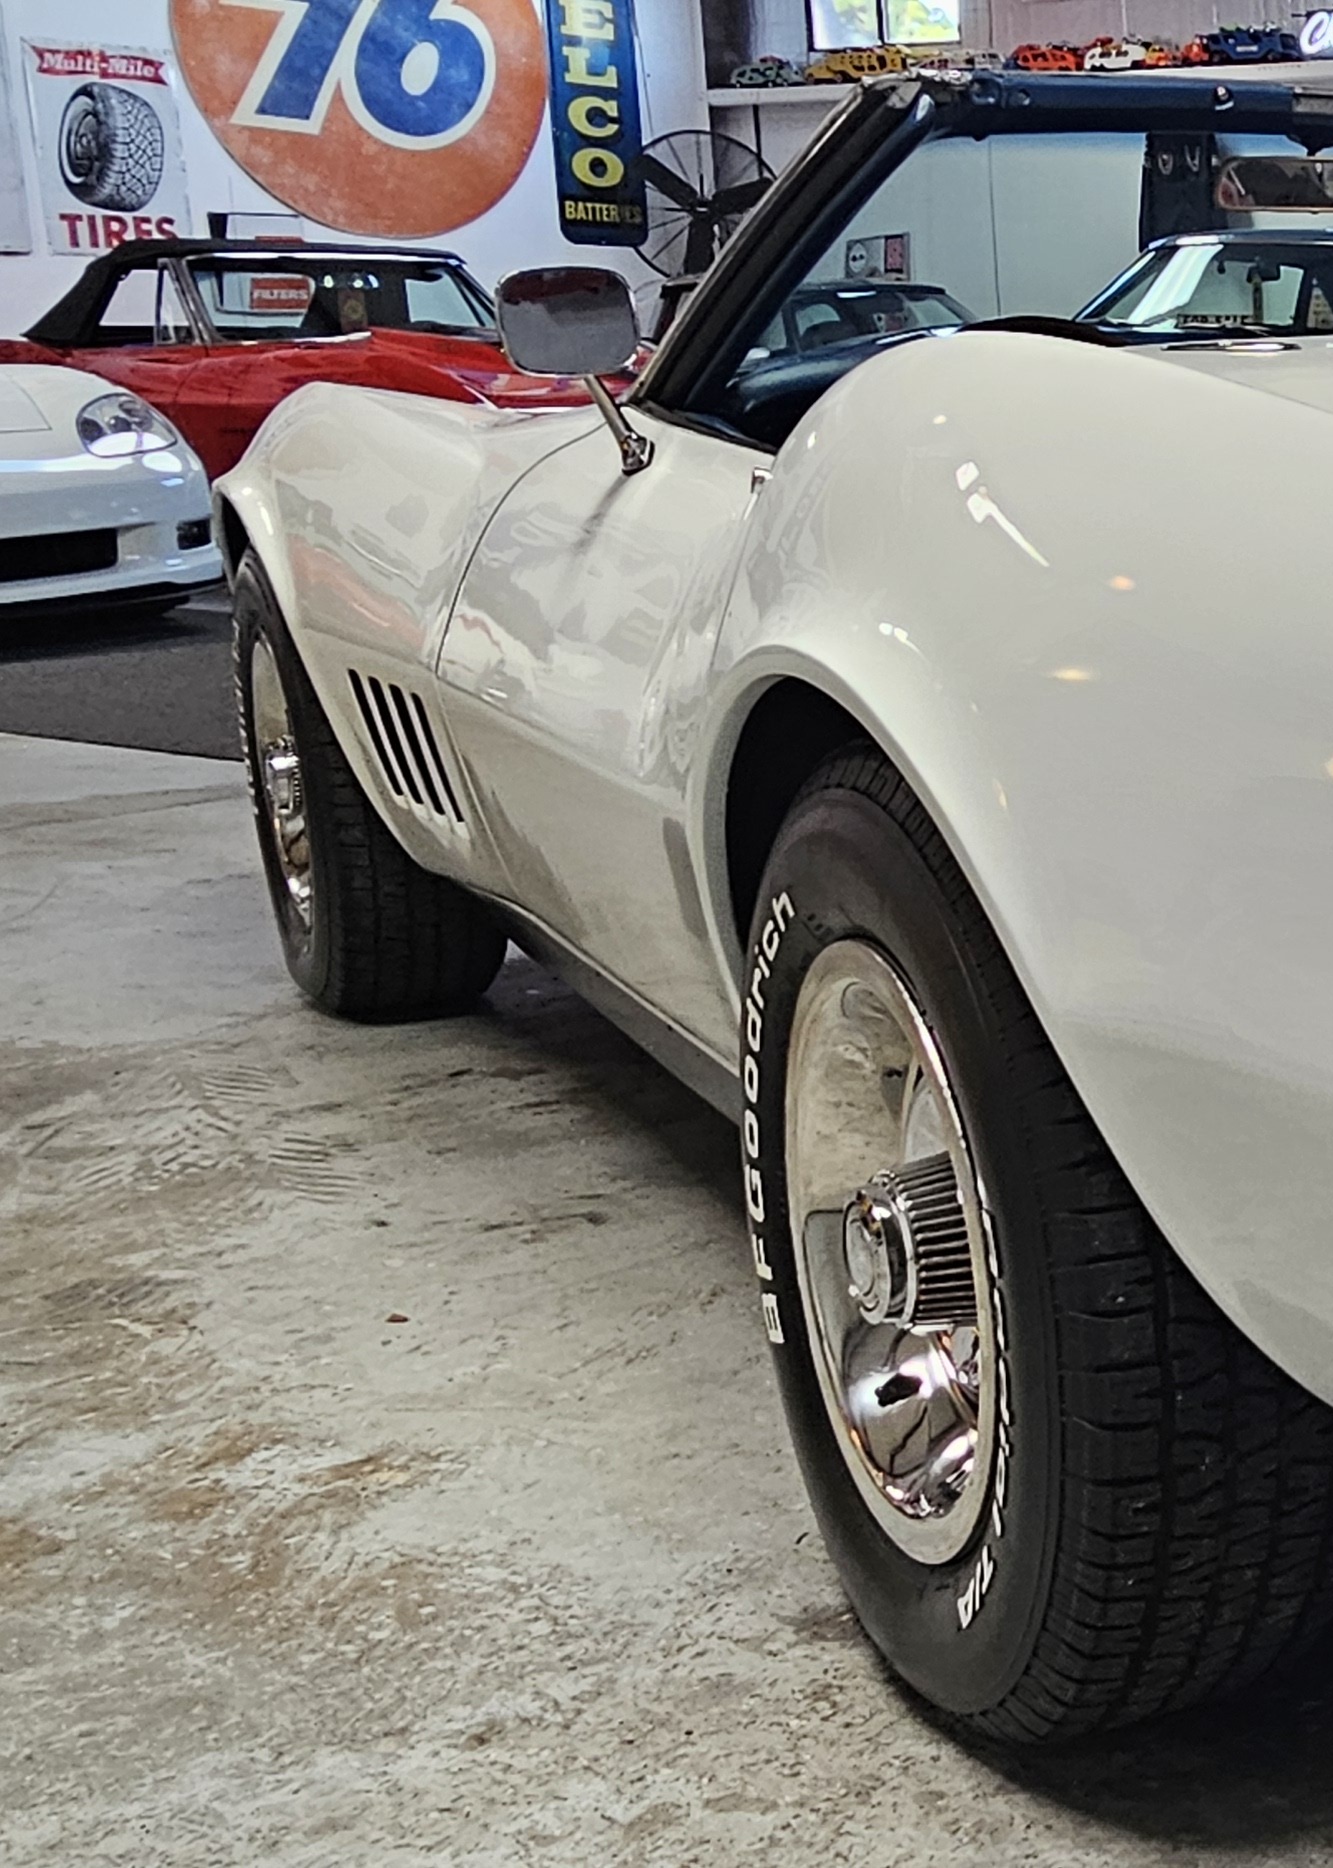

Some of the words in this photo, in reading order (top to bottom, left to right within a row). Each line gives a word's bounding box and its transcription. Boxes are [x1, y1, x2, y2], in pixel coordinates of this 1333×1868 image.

[42, 52, 156, 78] Multi-Mile
[219, 0, 496, 150] 76
[559, 0, 625, 188] ELCO
[59, 213, 178, 248] TIRES
[253, 288, 308, 300] FILTERS
